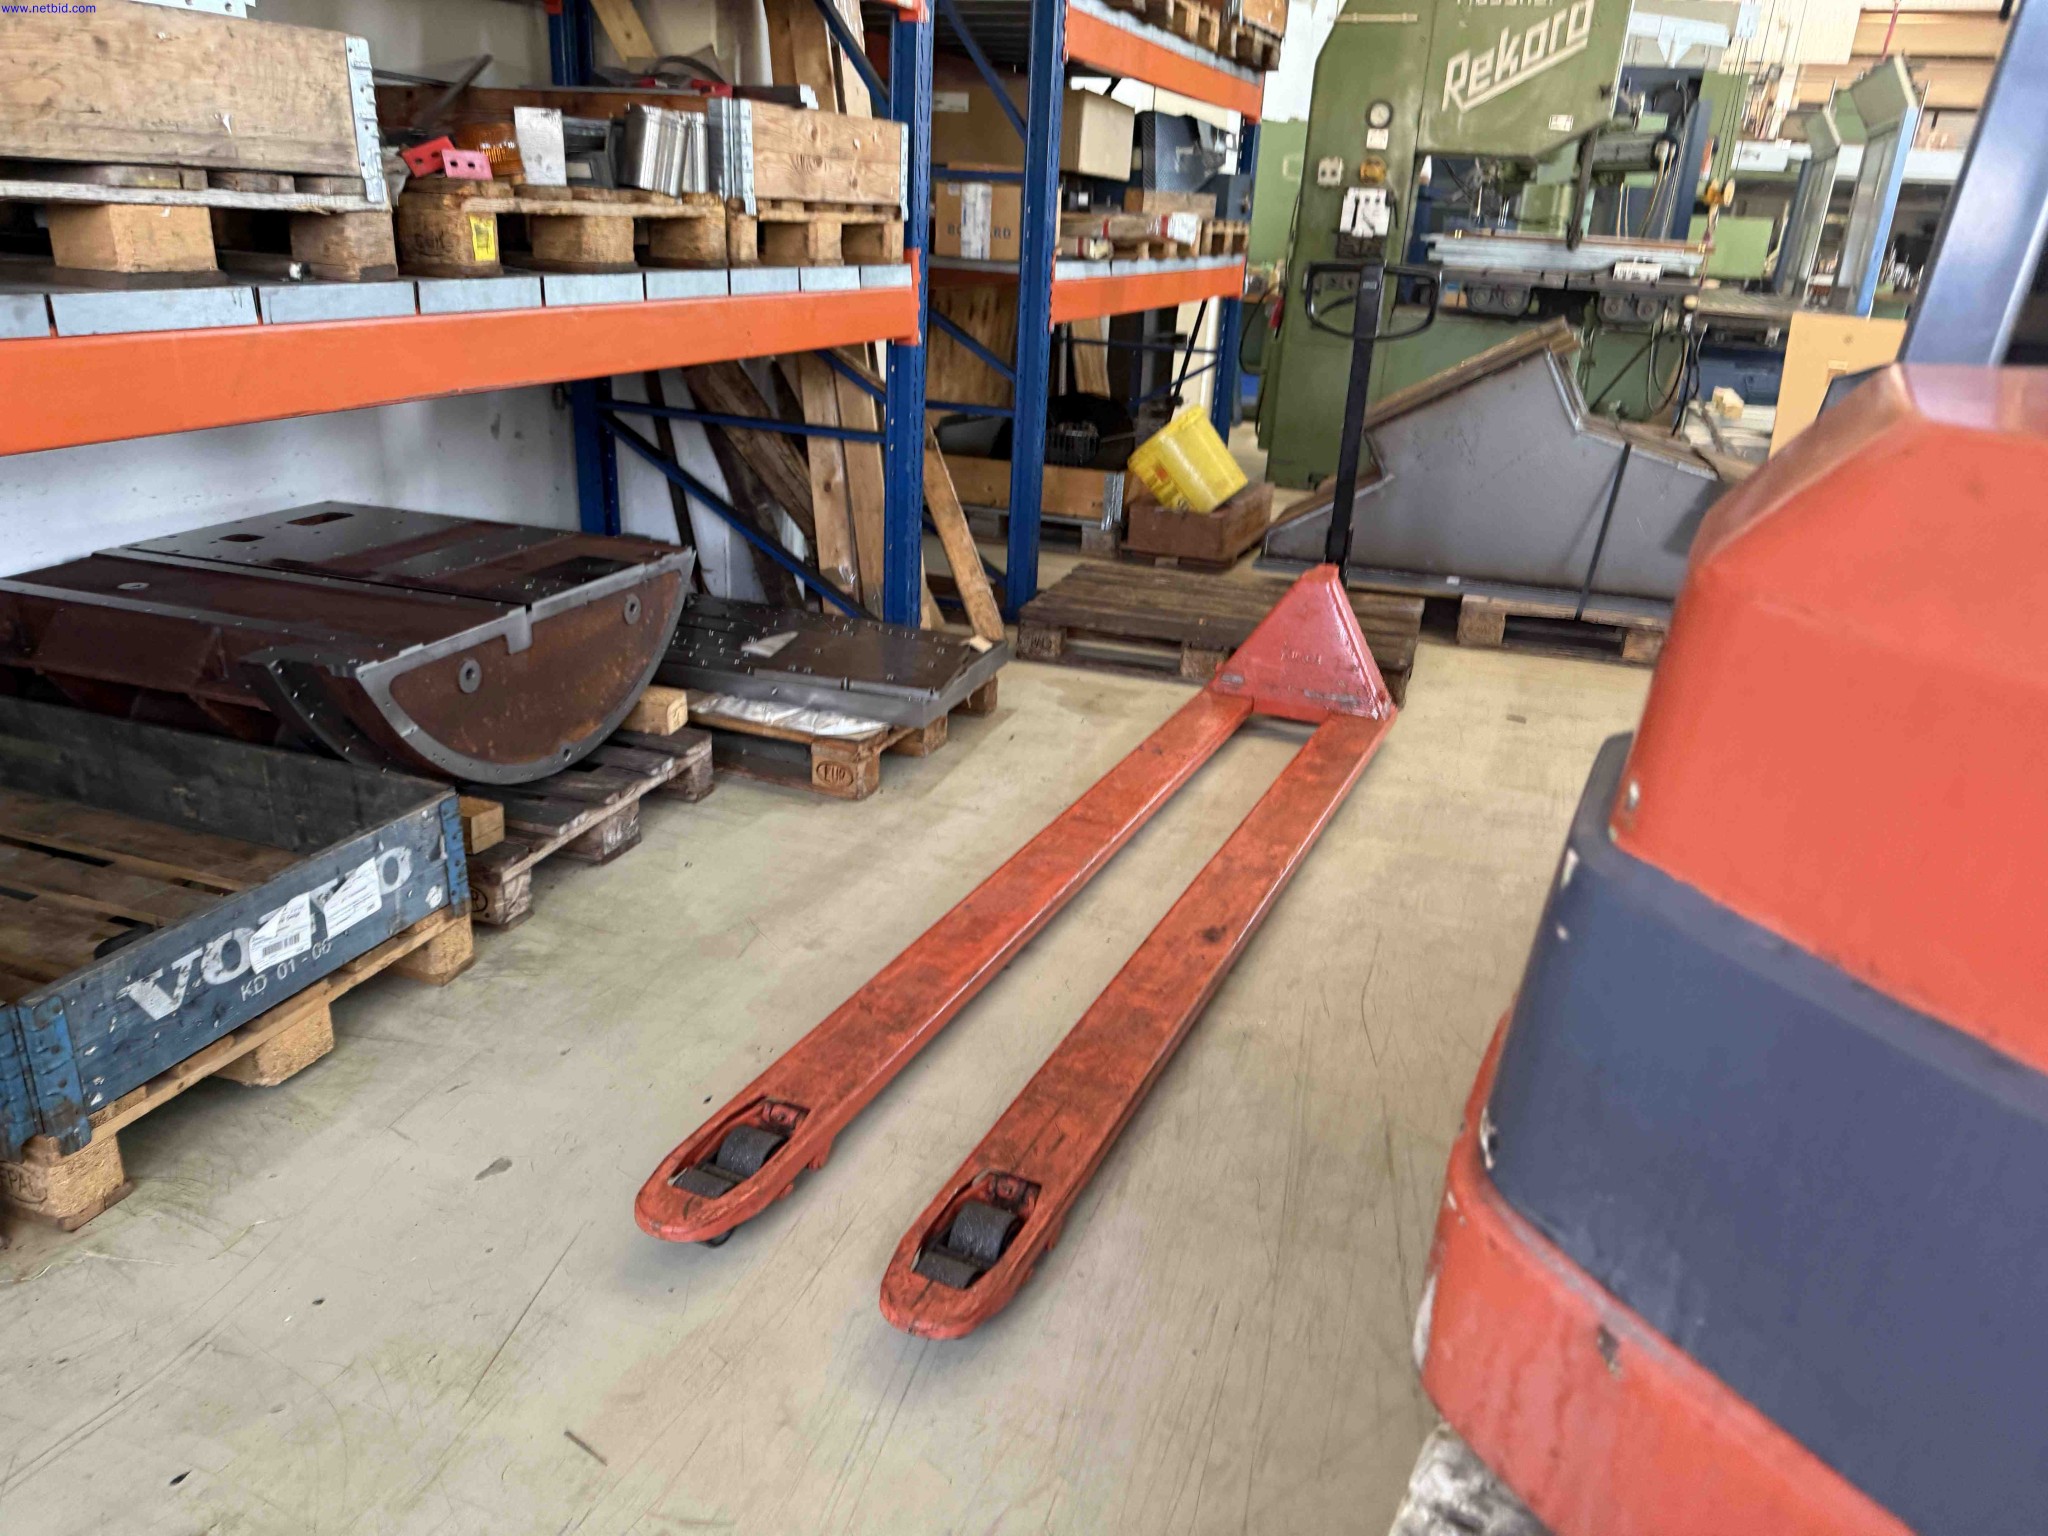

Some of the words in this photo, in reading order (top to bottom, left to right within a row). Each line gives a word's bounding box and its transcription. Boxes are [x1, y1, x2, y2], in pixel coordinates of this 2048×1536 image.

[1441, 0, 1595, 113] Rekord
[117, 846, 412, 1021] VOO
[240, 974, 268, 1002] KD
[276, 958, 296, 981] 01
